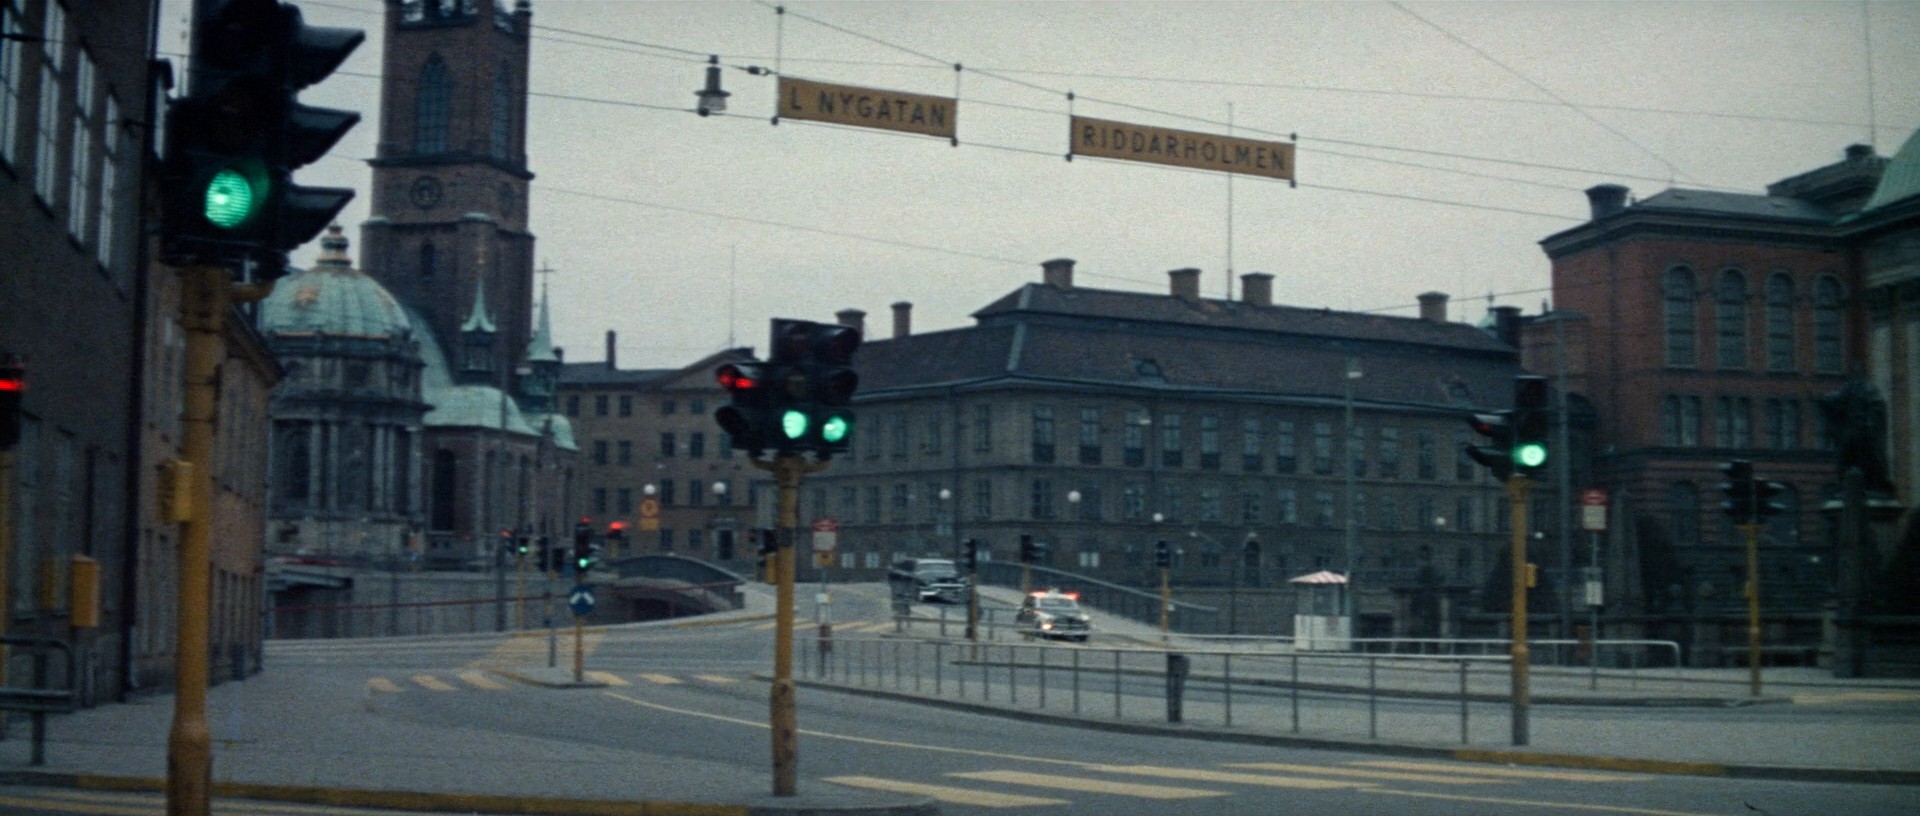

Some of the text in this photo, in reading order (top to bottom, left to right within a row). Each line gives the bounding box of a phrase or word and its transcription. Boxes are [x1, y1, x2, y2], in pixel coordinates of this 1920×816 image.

[790, 87, 945, 127] L NYGATAN
[1083, 125, 1285, 170] RIDDARHOLMEN
